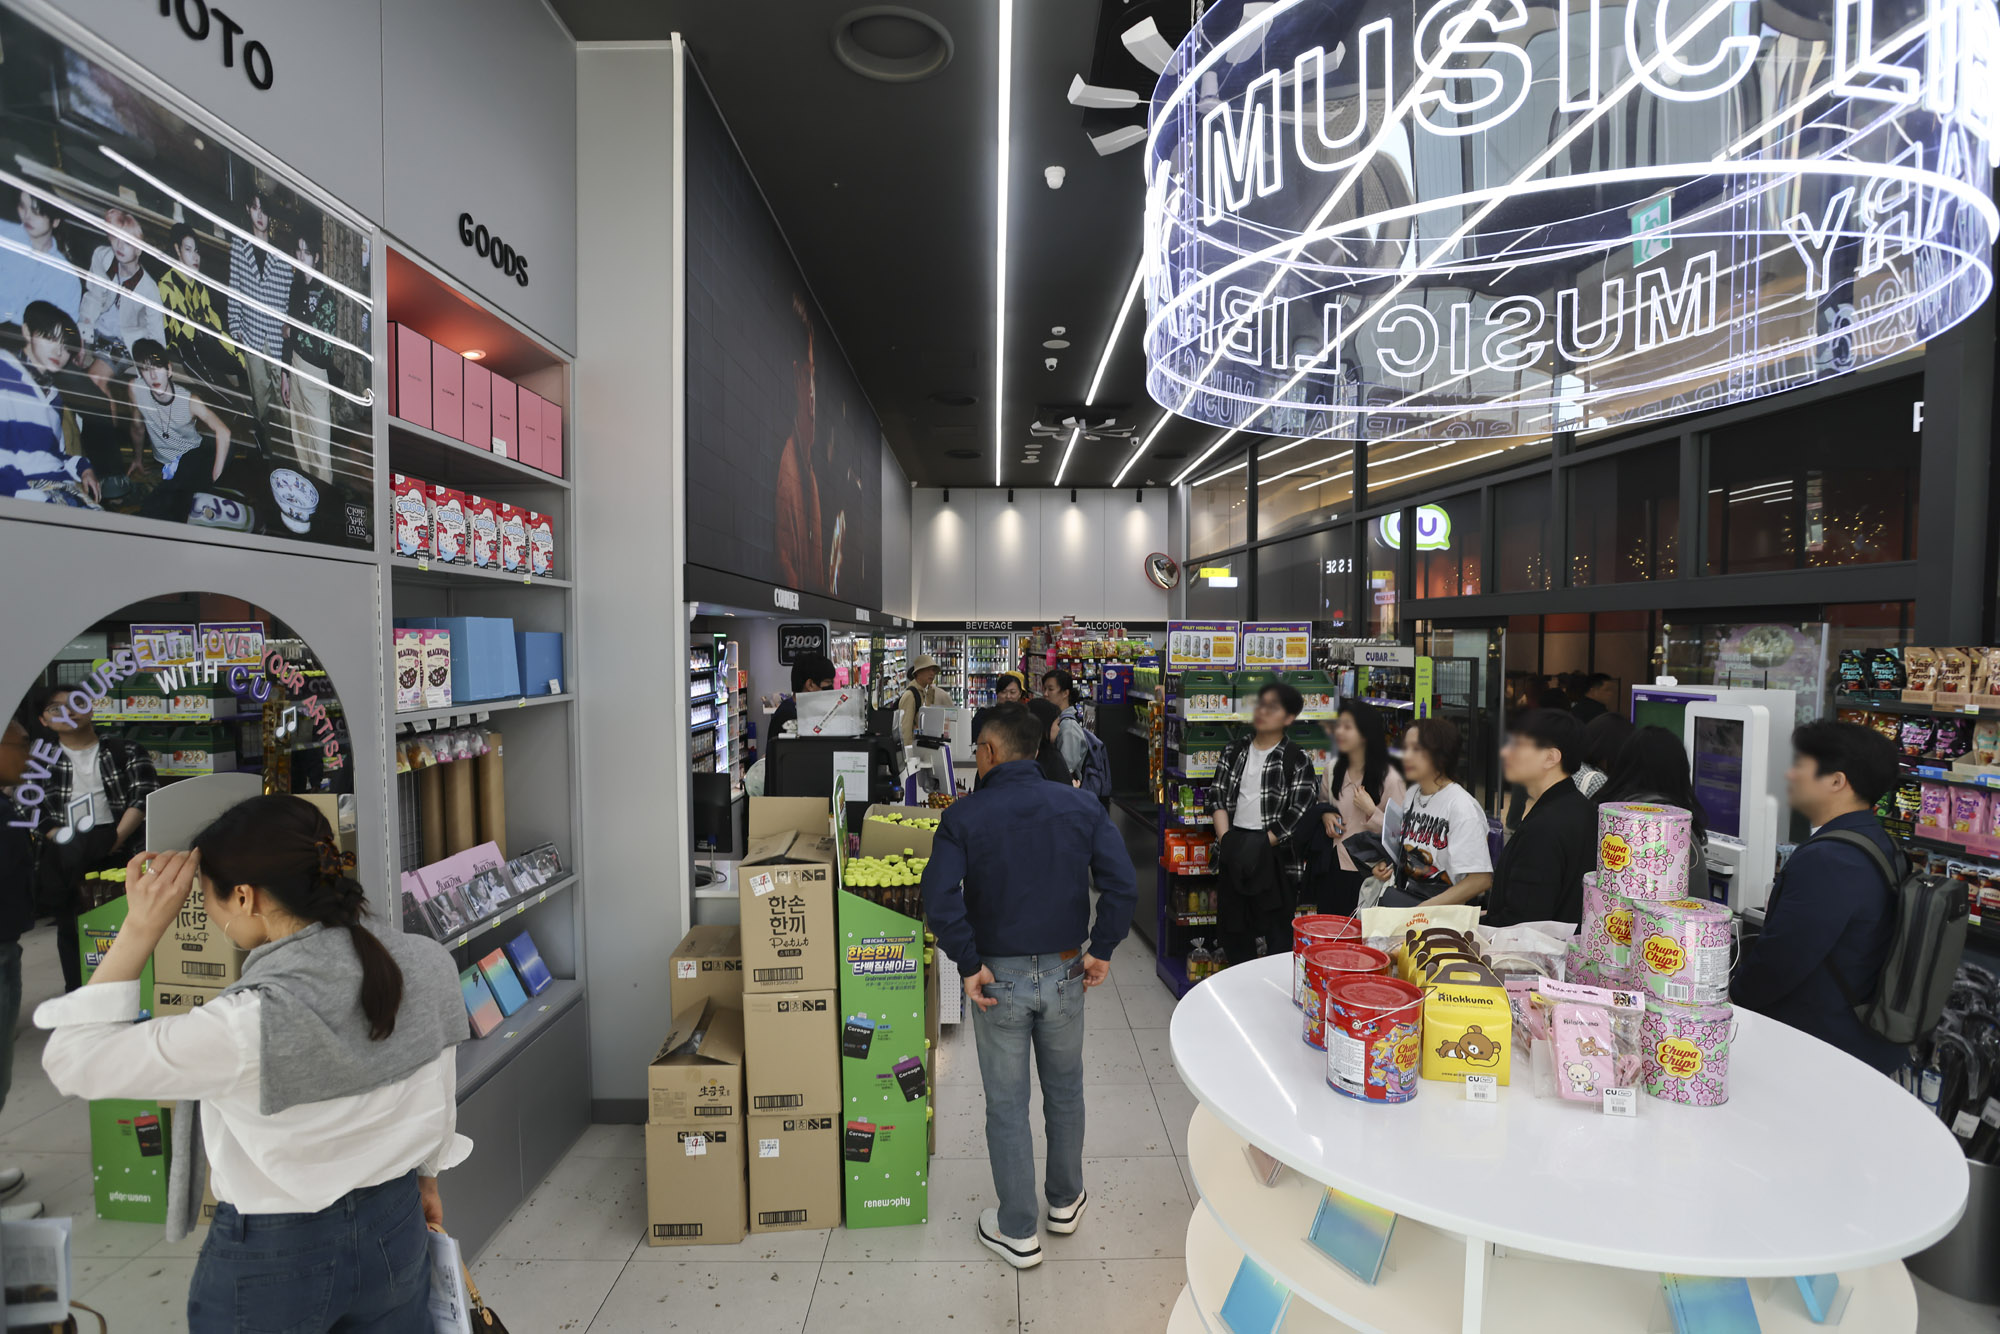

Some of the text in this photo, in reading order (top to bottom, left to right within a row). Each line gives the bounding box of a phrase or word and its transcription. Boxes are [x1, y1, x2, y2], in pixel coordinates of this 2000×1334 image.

[1202, 0, 1763, 225] MUSIC
[458, 212, 530, 288] GOODS
[348, 526, 366, 536] EYES
[966, 621, 1013, 630] BEVERAGE
[1085, 621, 1125, 630] ALCOHOL
[397, 648, 419, 659] BLACKPINK
[427, 648, 450, 659] BLACKPINK
[154, 660, 273, 703] WITH CU
[8, 629, 345, 829] LOVE YOURSELF LOVE YOUR ARTIST
[1602, 841, 1627, 854] Chupa
[1601, 849, 1626, 865] Chups
[768, 895, 806, 915] 한손
[769, 915, 806, 936] 한끼
[769, 937, 810, 949] Petit
[1647, 943, 1680, 957] Chupa
[847, 945, 904, 962] 한손한끼
[1645, 951, 1679, 970] Chups
[853, 959, 917, 974] 단백질쉐이크
[1437, 992, 1494, 1005] Rilakkuma
[1661, 1044, 1700, 1060] Chupa
[1658, 1054, 1697, 1072] Chups
